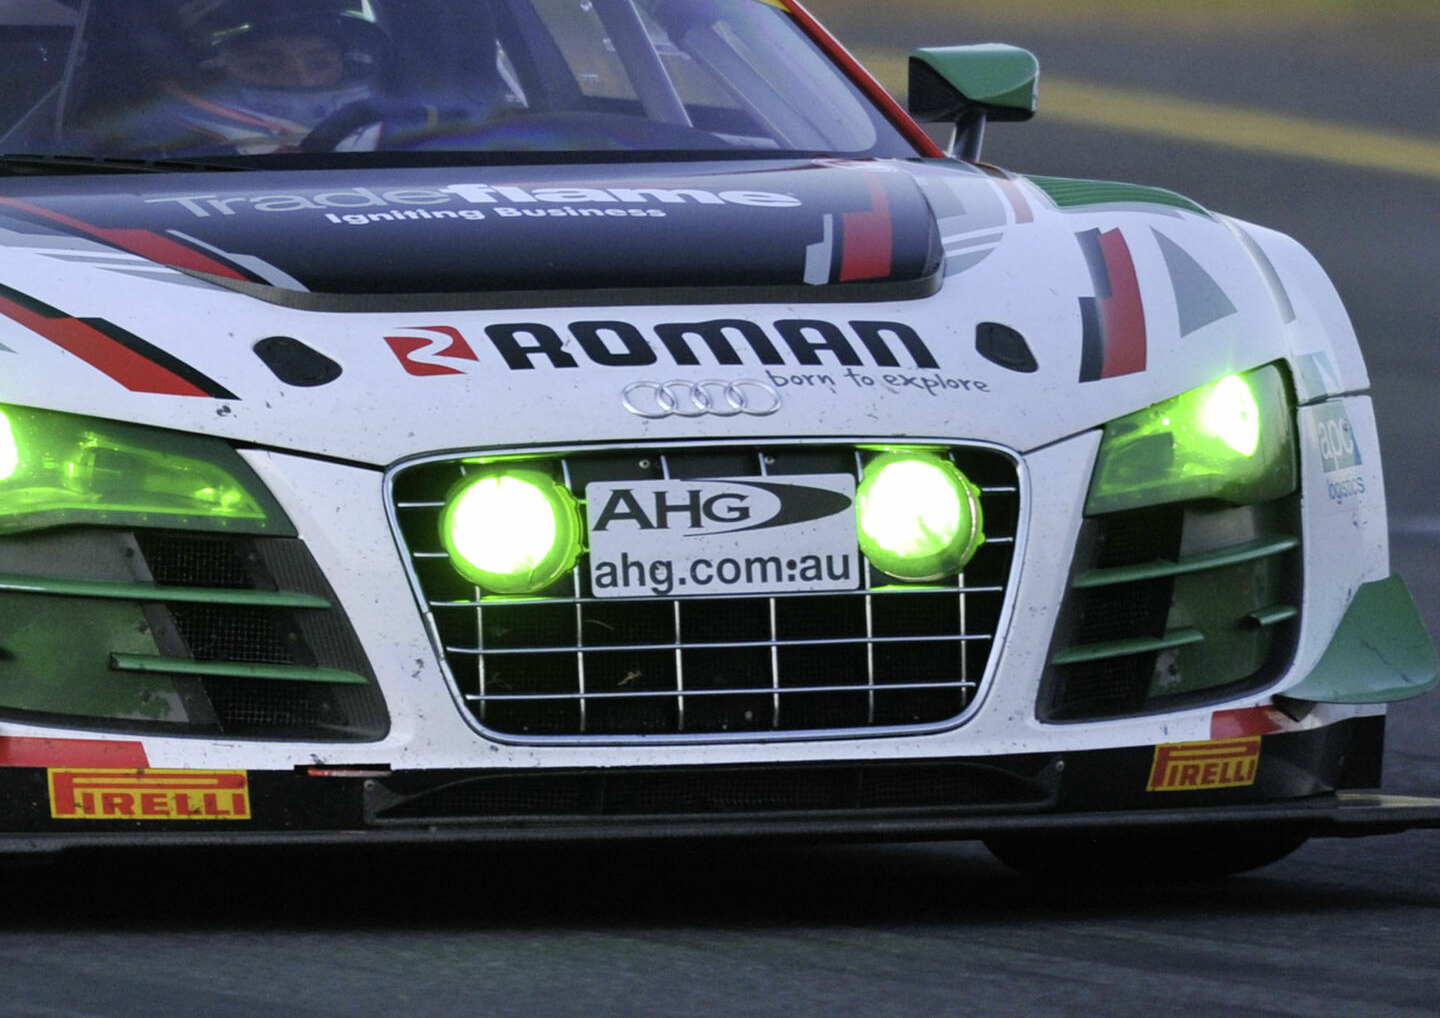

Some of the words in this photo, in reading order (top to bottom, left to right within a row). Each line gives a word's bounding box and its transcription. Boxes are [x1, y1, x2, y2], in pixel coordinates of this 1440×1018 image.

[144, 183, 802, 218] Tradeflame
[325, 208, 486, 226] Igniting
[493, 207, 667, 218] Business
[484, 319, 940, 370] ROMAN
[765, 370, 836, 388] born
[844, 368, 875, 388] to
[883, 373, 992, 397] explore
[1318, 418, 1354, 471] apc
[592, 488, 751, 531] AHG
[594, 552, 850, 595] ahg.com.au
[1150, 740, 1260, 787] PIRELLI
[52, 771, 247, 816] PIRELLI
